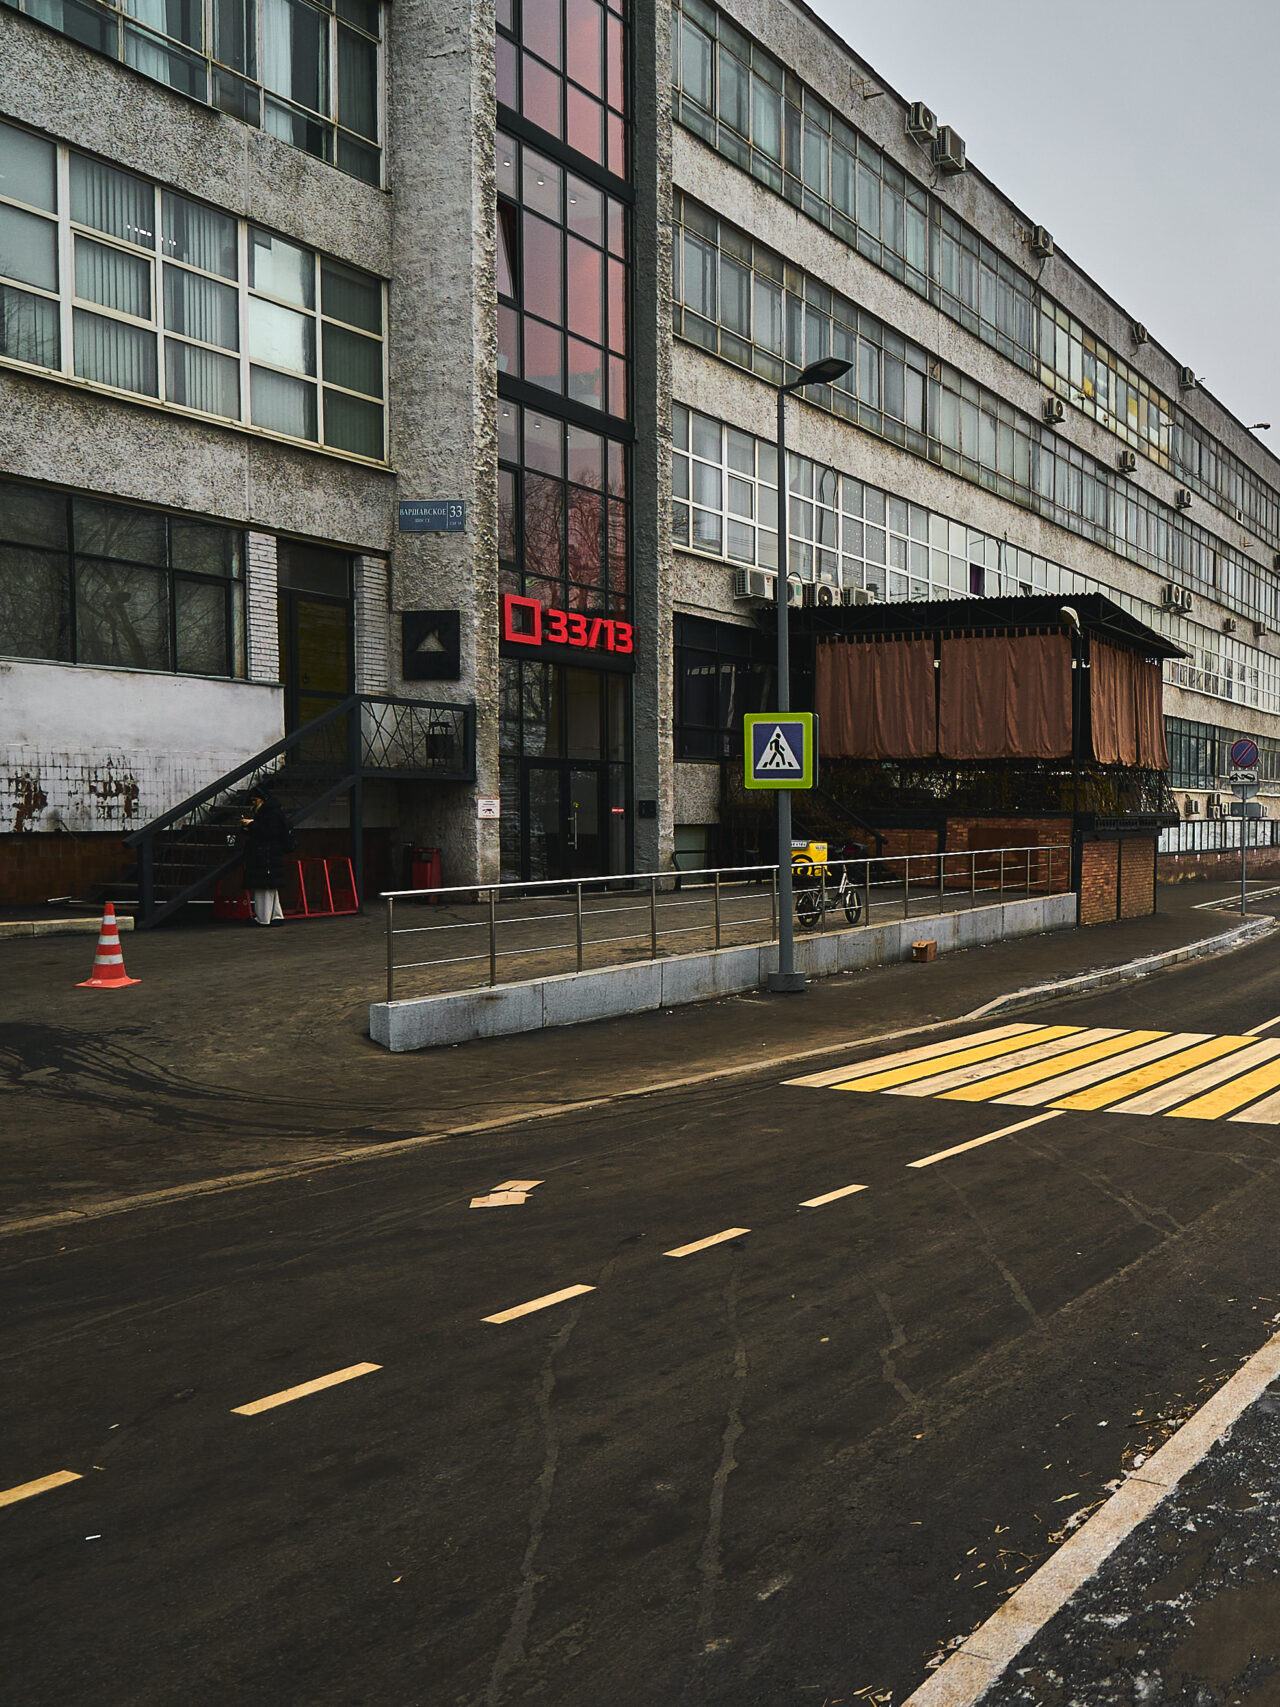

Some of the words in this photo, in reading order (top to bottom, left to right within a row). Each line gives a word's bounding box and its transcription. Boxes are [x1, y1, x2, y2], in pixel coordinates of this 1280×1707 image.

[400, 508, 447, 516] ВАРШАВСКОЕ
[449, 505, 463, 518] 33
[547, 609, 634, 654] 33/13
